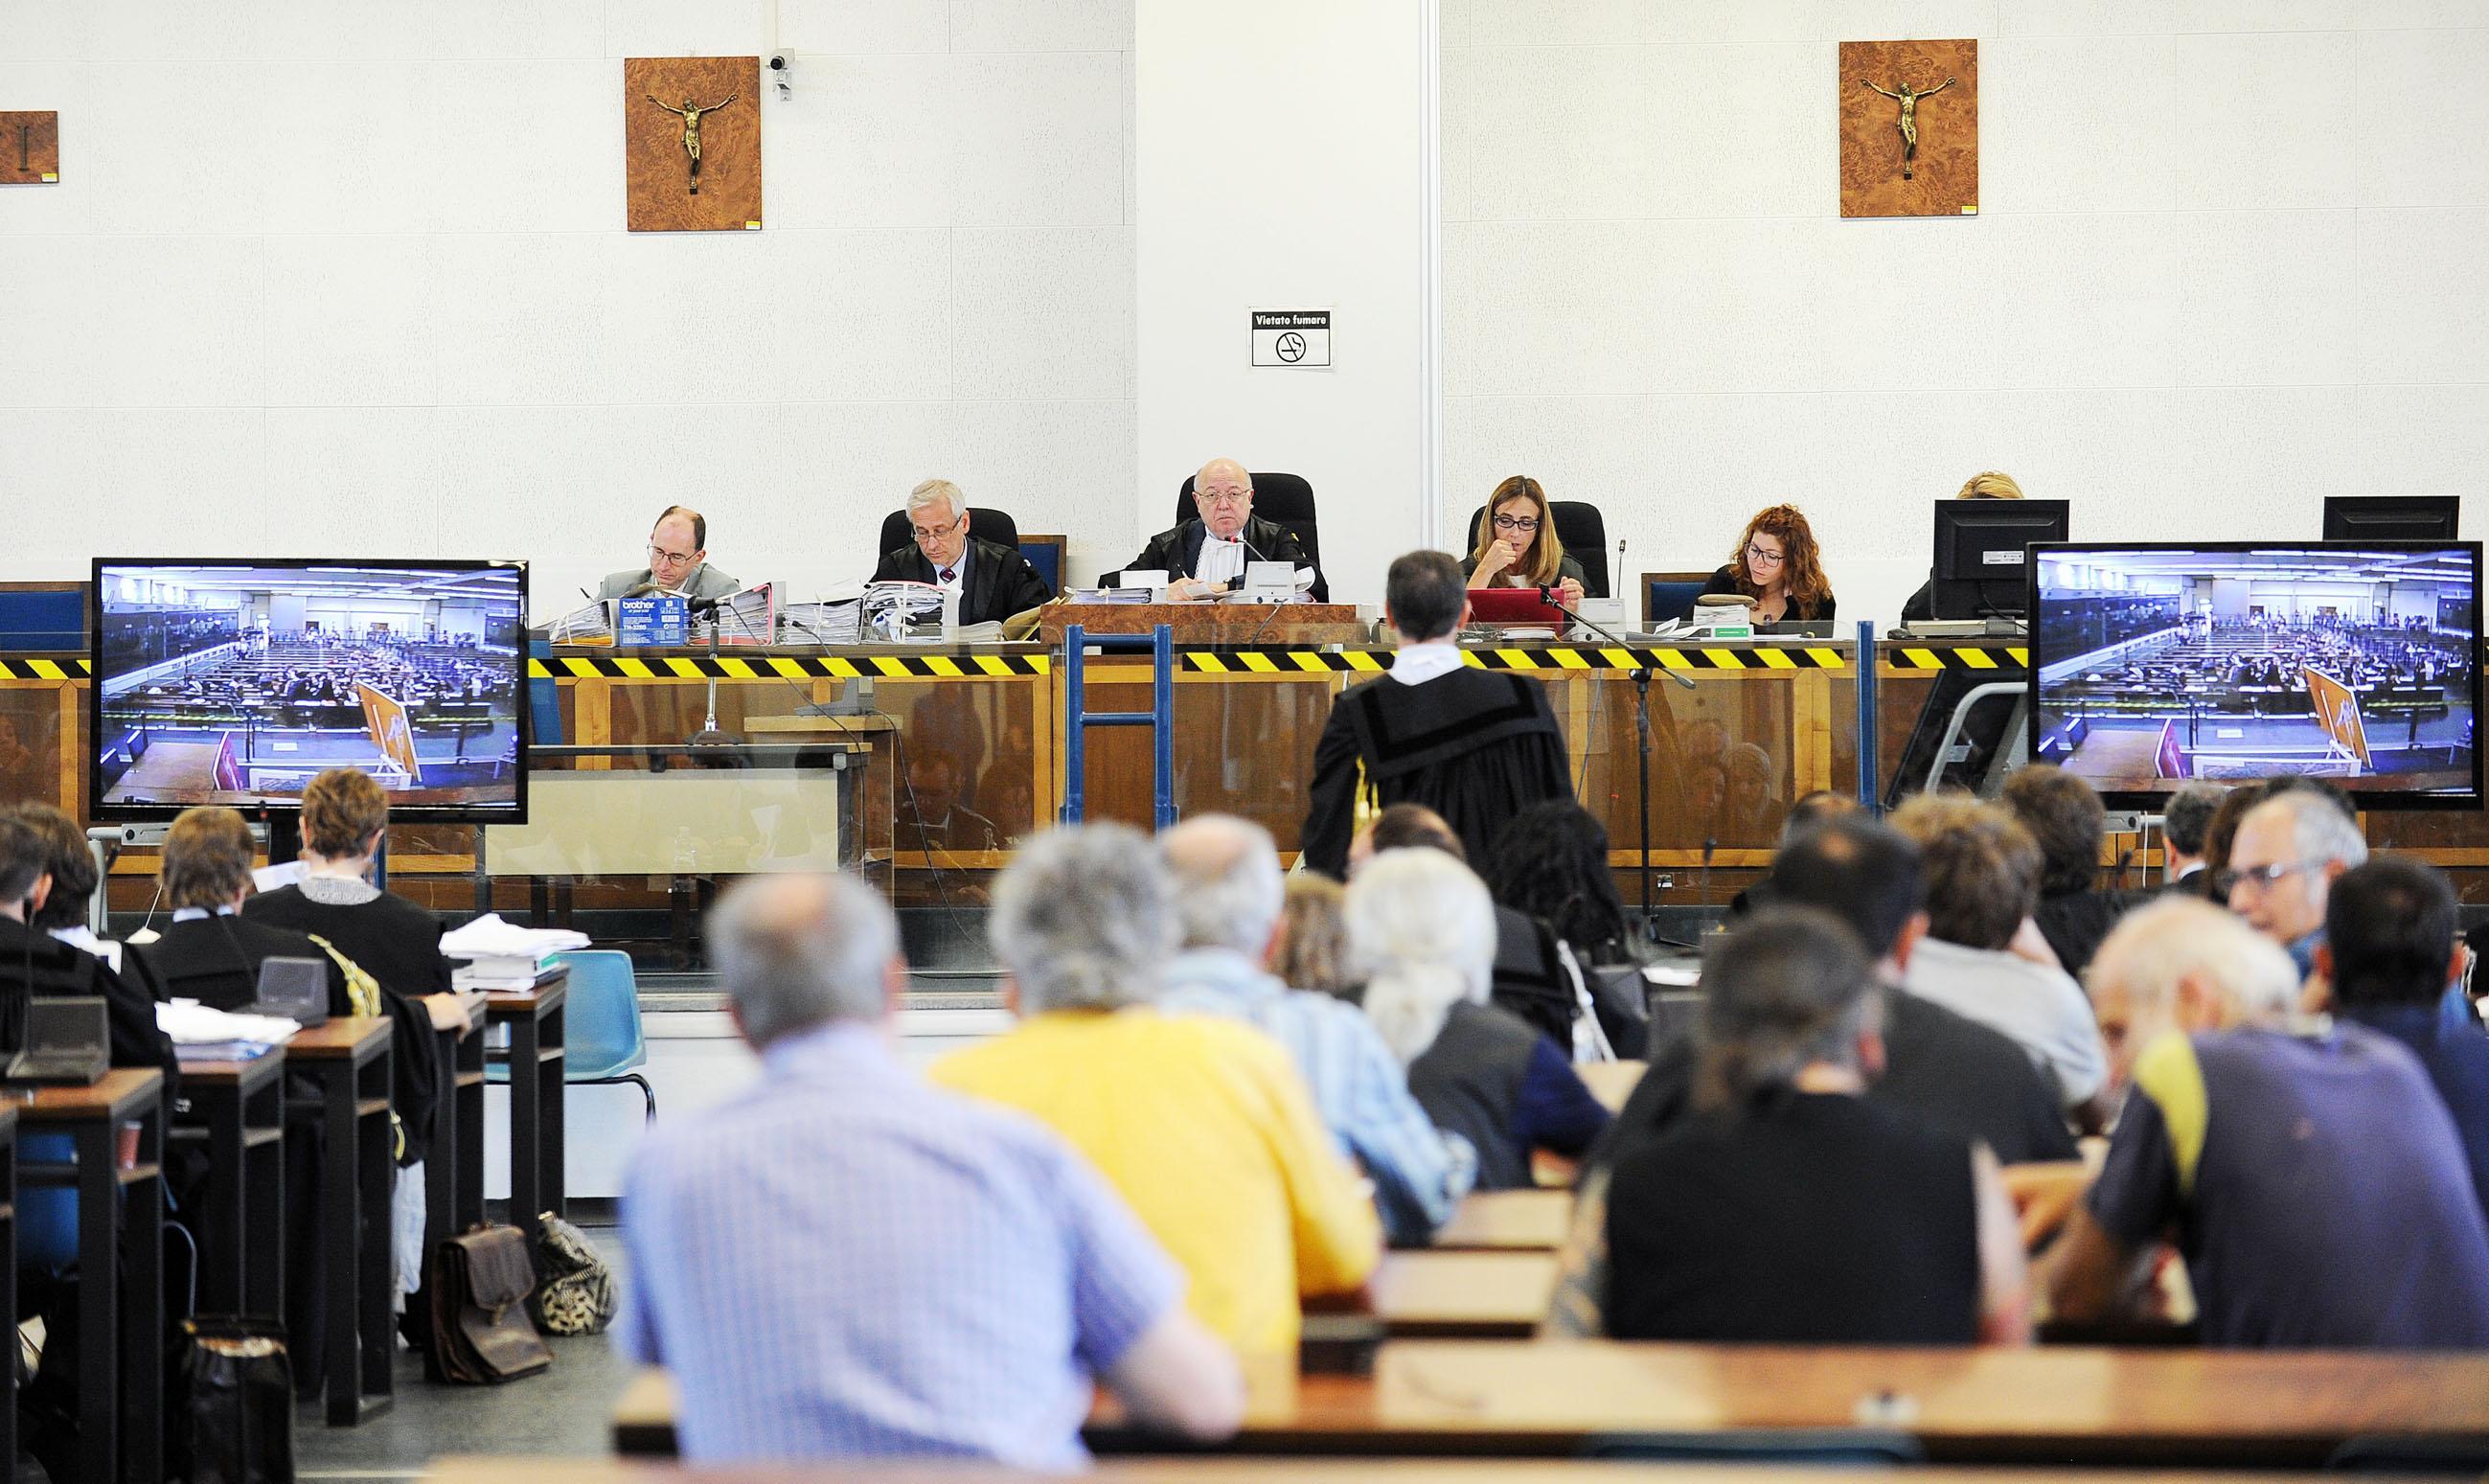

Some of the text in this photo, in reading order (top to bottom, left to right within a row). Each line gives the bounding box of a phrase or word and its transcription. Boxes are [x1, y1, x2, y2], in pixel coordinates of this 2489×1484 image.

[1256, 314, 1326, 325] Vietato fumare
[623, 601, 654, 609] brother
